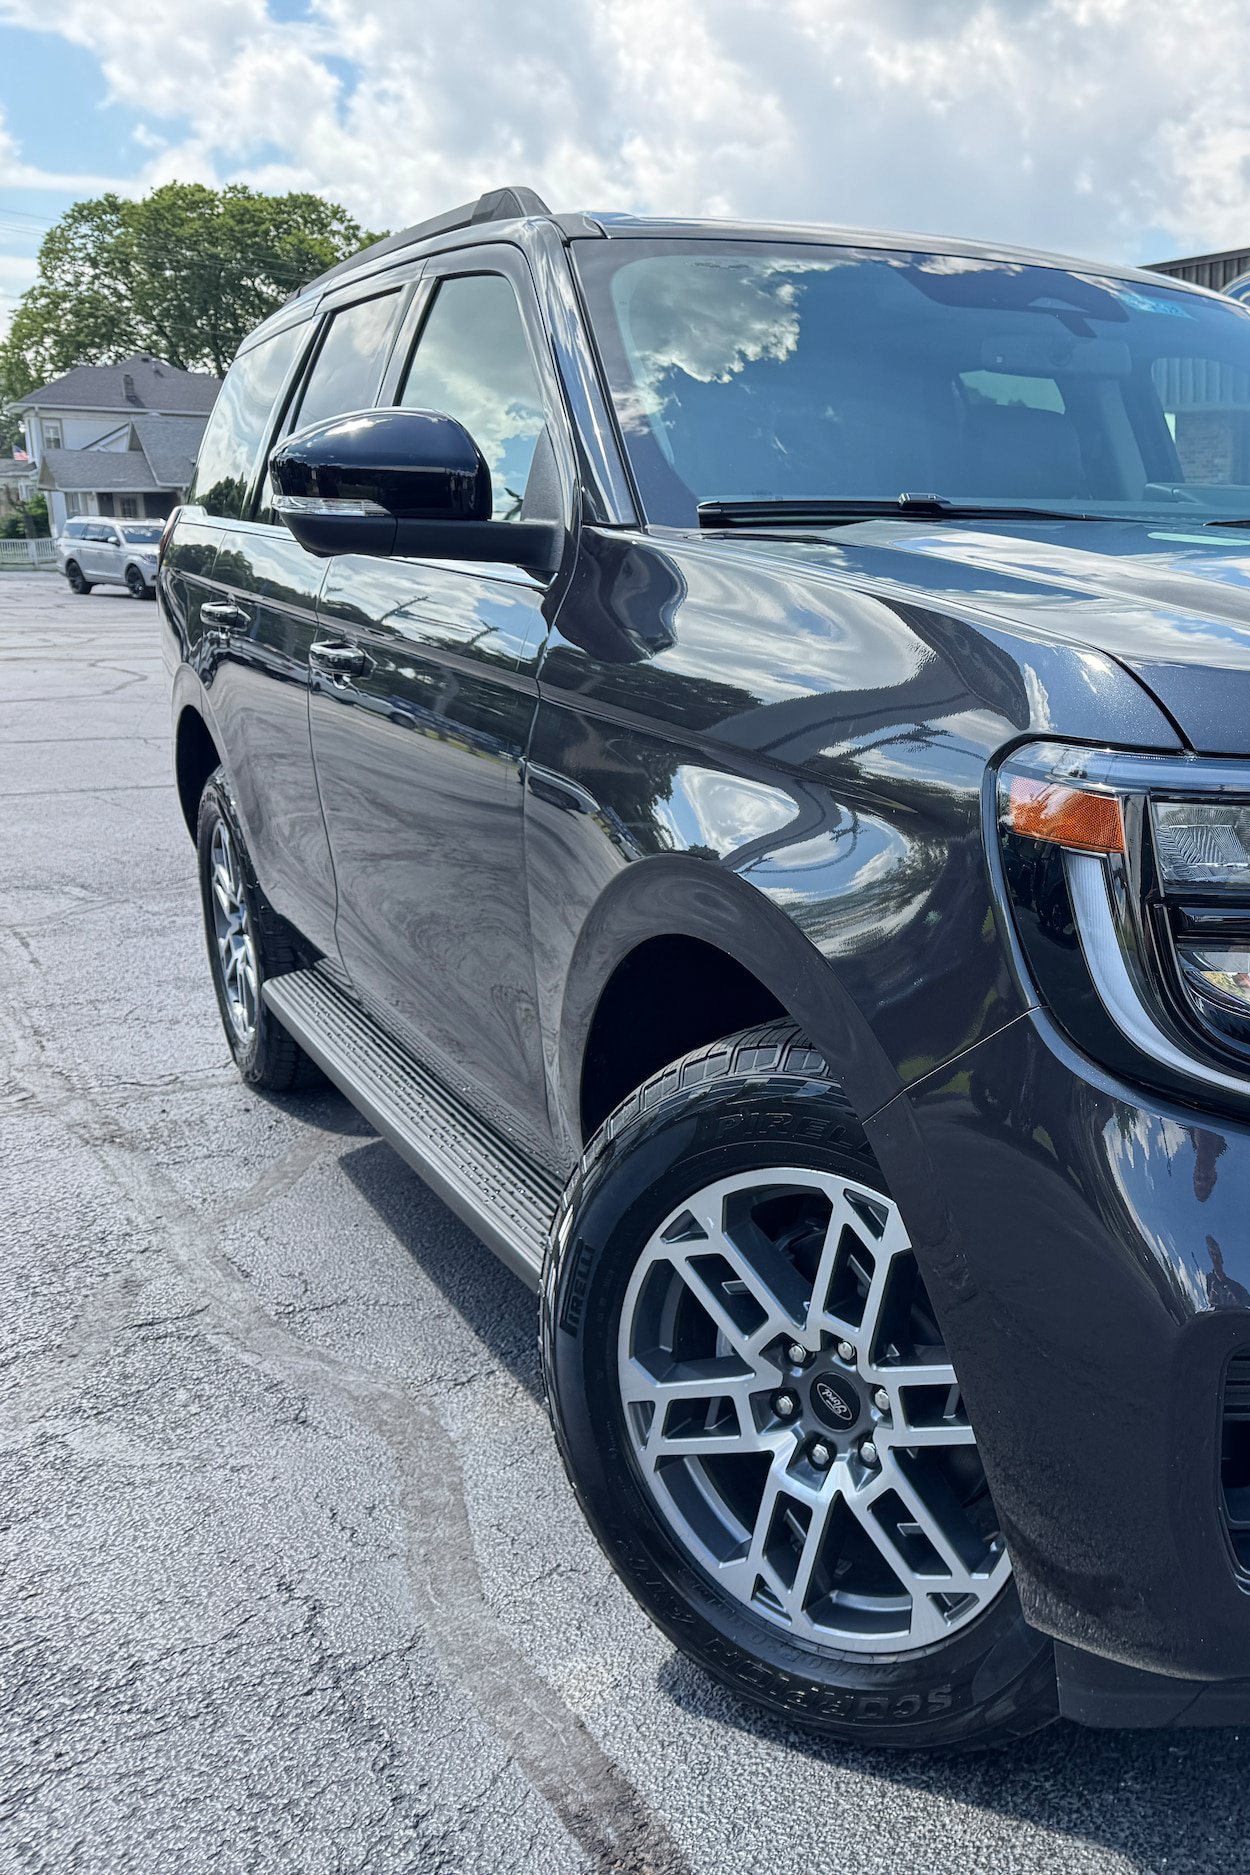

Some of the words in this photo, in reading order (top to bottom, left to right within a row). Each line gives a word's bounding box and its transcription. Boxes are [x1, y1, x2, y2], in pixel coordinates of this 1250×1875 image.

[560, 1238, 597, 1339] PIRELLI
[821, 1388, 848, 1415] Ford
[703, 1638, 952, 1720] SCORPION
